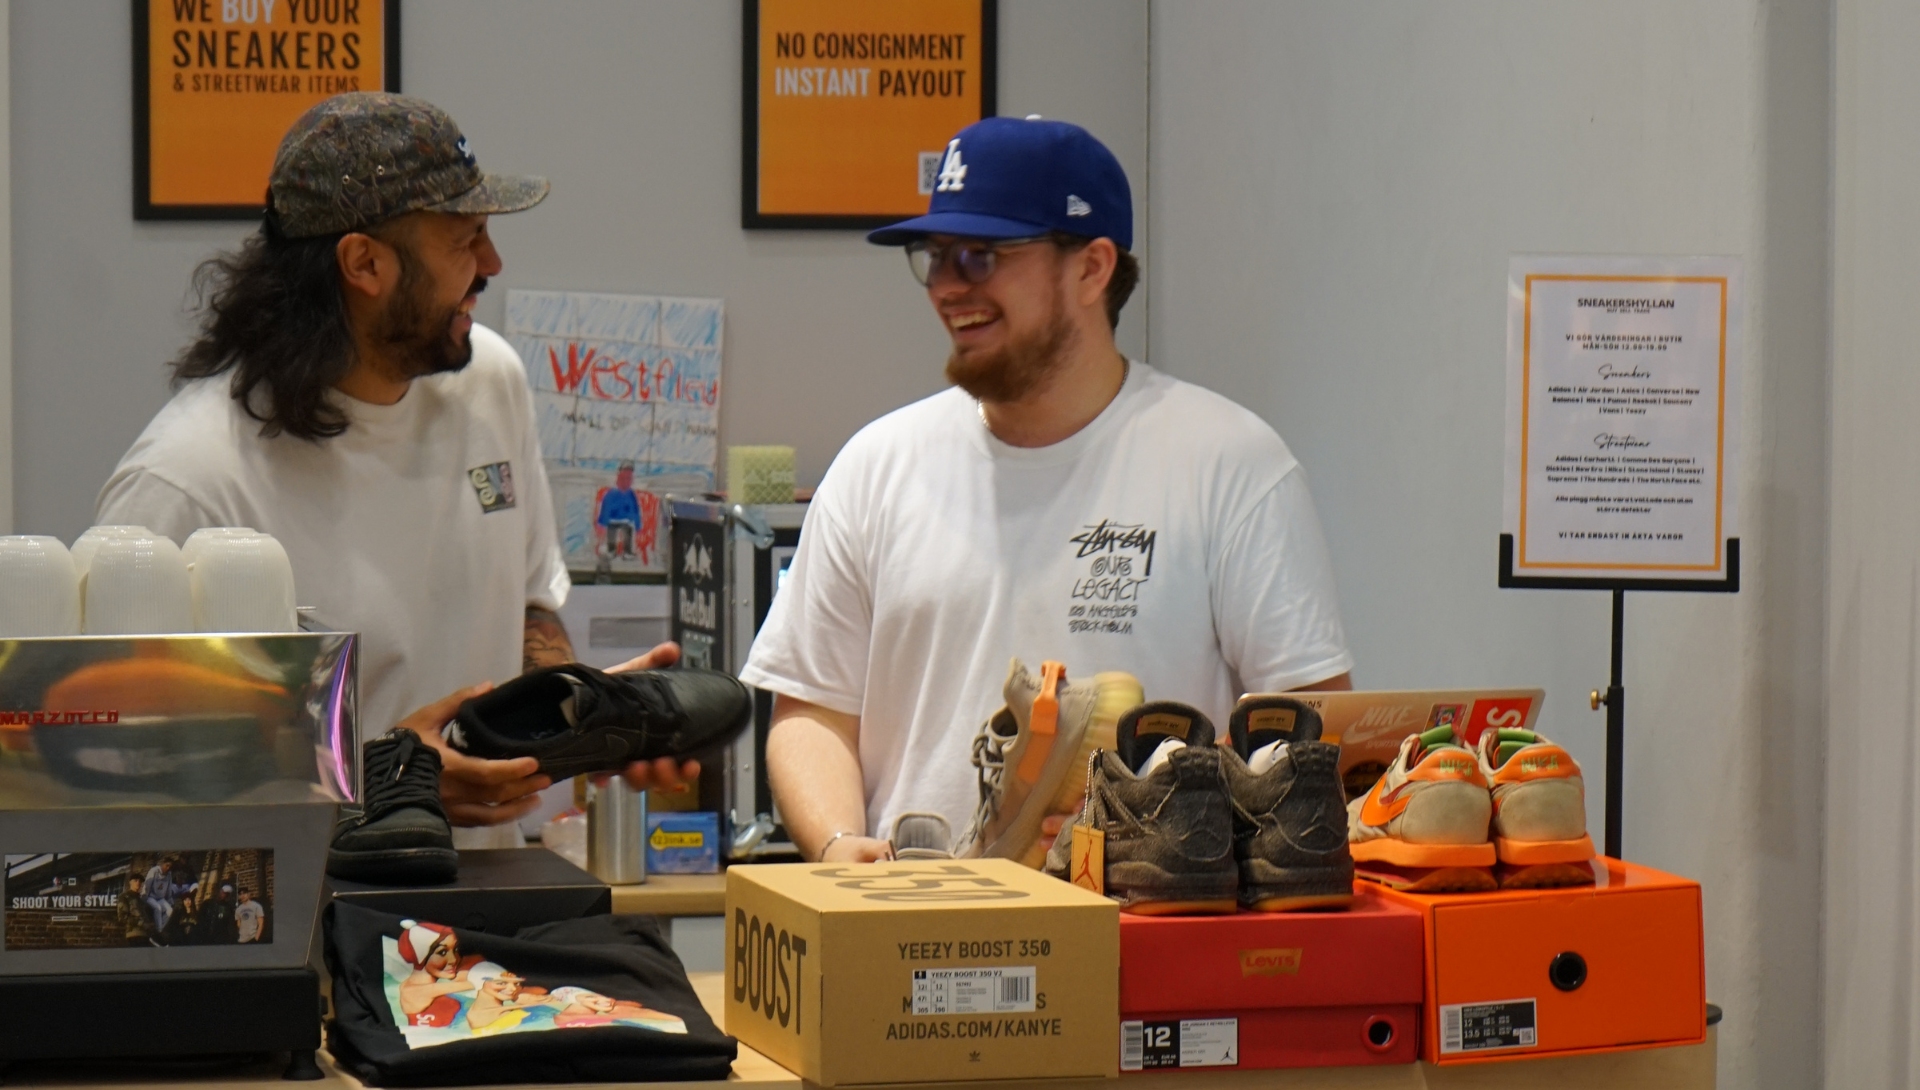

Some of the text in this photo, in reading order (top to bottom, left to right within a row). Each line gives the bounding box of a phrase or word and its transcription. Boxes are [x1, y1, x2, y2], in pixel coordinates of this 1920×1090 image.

[173, 0, 361, 25] WE BUY YOUR
[172, 30, 361, 70] SNEAKERS
[776, 32, 966, 60] NO CONSIGNMENT
[173, 73, 360, 94] & STREETWEAR ITEMS
[774, 67, 967, 97] INSTANT PAYOUT
[936, 138, 968, 192] LA
[1577, 298, 1675, 309] SNEAKERSHYLLAN
[1565, 333, 1574, 341] VI
[1659, 335, 1683, 344] BUTIK
[1598, 363, 1651, 380] Sneakers
[1547, 385, 1572, 394] Adidas
[1590, 386, 1615, 395] Jordan
[1621, 386, 1640, 395] Asics
[1646, 387, 1681, 395] Converse
[1552, 395, 1580, 404] Balance
[1593, 432, 1651, 450] Streetwear
[1545, 464, 1571, 473] Dickies
[1555, 454, 1579, 463] Adidas
[1558, 531, 1567, 539] VI
[1569, 531, 1586, 540] TAR
[1587, 532, 1619, 540] ENDAST
[1358, 706, 1413, 727] NIKE
[810, 866, 1031, 902] 350
[12, 893, 118, 910] SHOOT YOUR STYLE
[897, 939, 1051, 961] YEEZY BOOST 350
[733, 907, 807, 1037] BOOST
[979, 970, 993, 978] 350
[993, 970, 1003, 978] V2
[885, 1018, 1062, 1041] ADIDAS.COM/KANYE
[1143, 1026, 1171, 1048] 12
